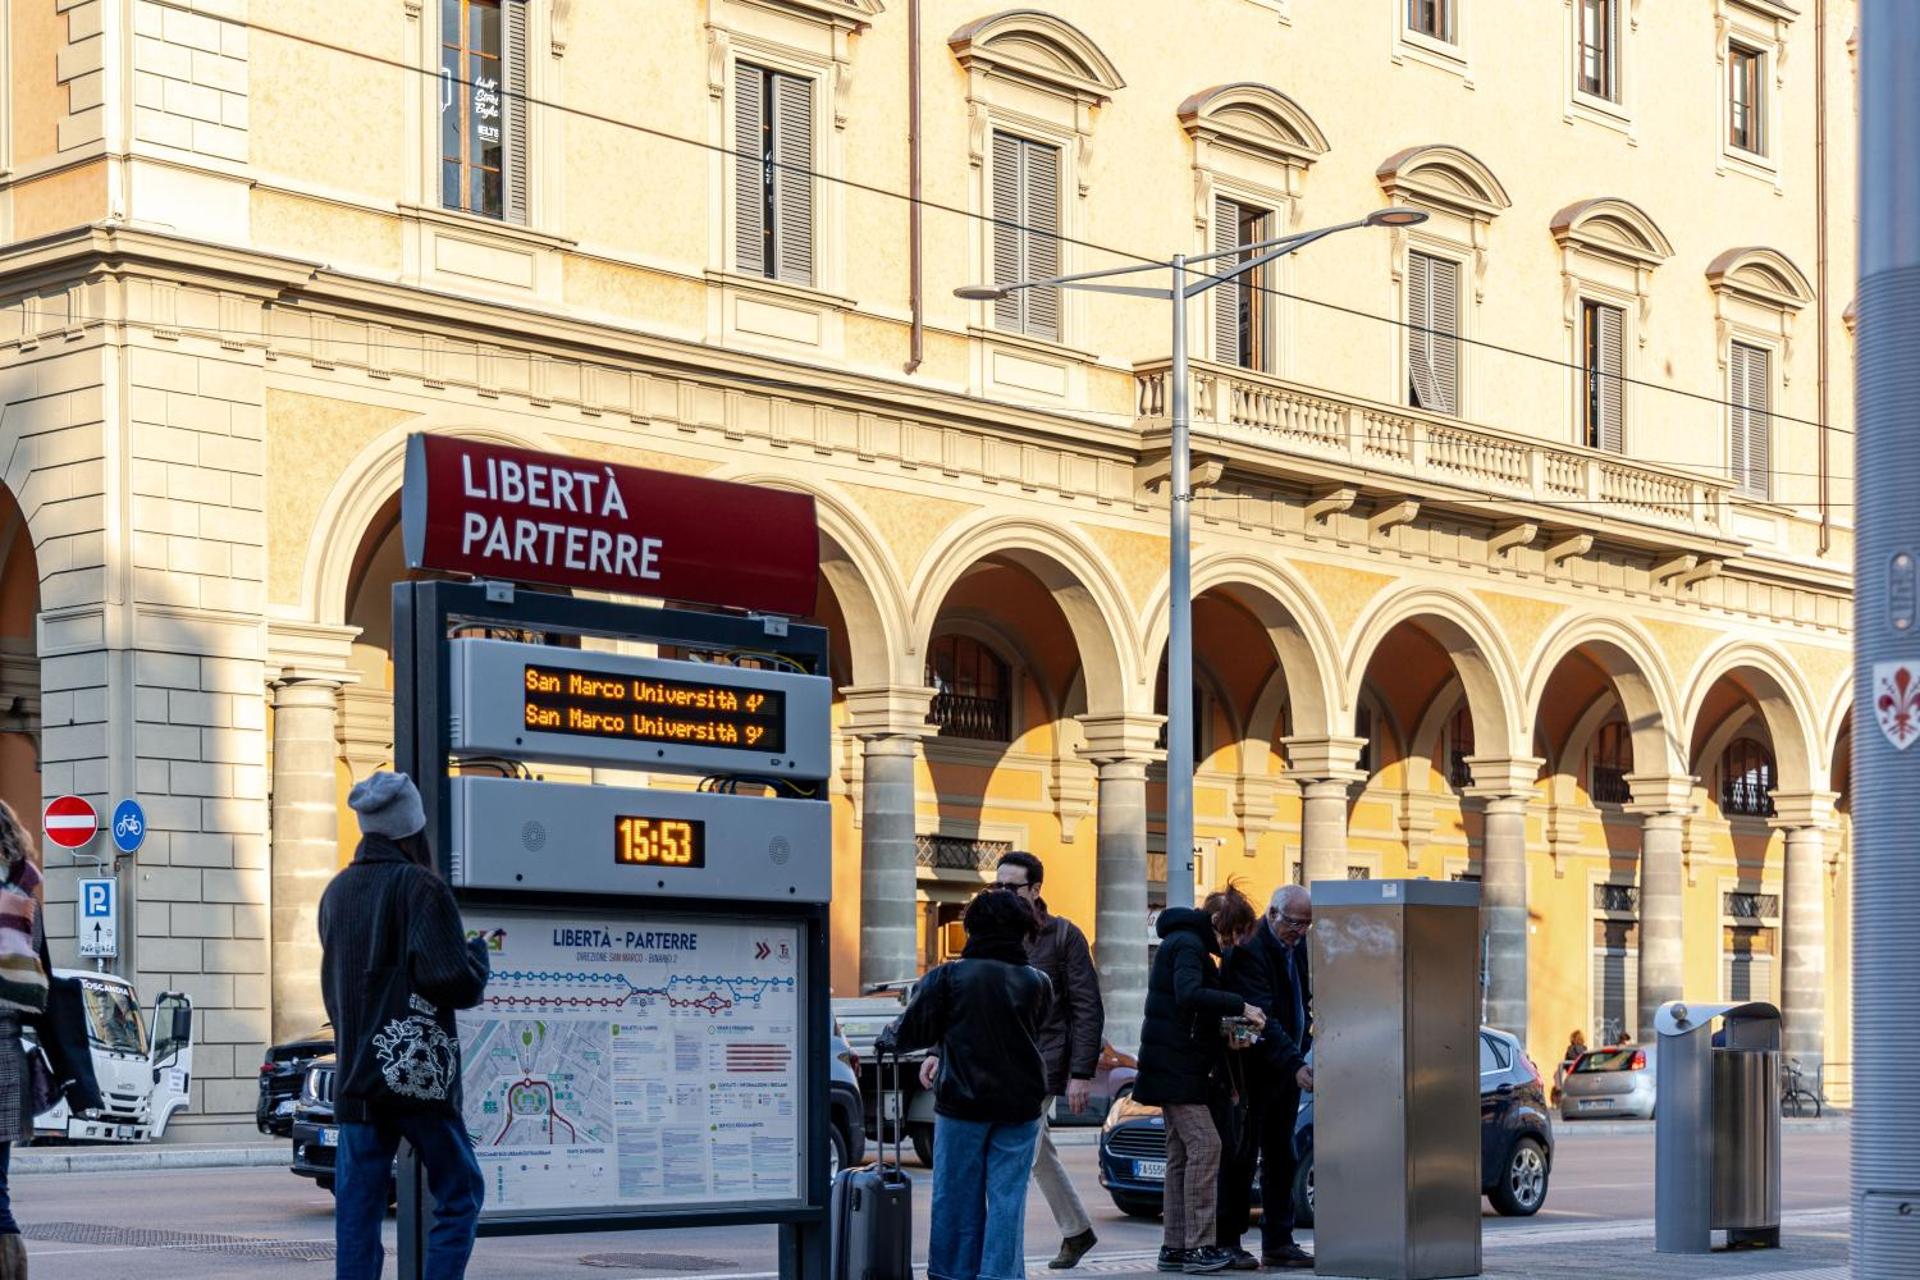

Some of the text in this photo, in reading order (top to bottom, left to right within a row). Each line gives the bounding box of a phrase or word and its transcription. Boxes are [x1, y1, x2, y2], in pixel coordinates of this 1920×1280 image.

[462, 453, 629, 520] LIBERTÀ
[462, 511, 663, 580] PARTERRE
[525, 669, 560, 692] San
[569, 674, 625, 699] Marco
[525, 703, 560, 727] San
[569, 707, 625, 732] Marco
[619, 819, 693, 863] 15:53
[553, 925, 612, 949] LIBERTÀ
[625, 930, 698, 951] PARTERRE
